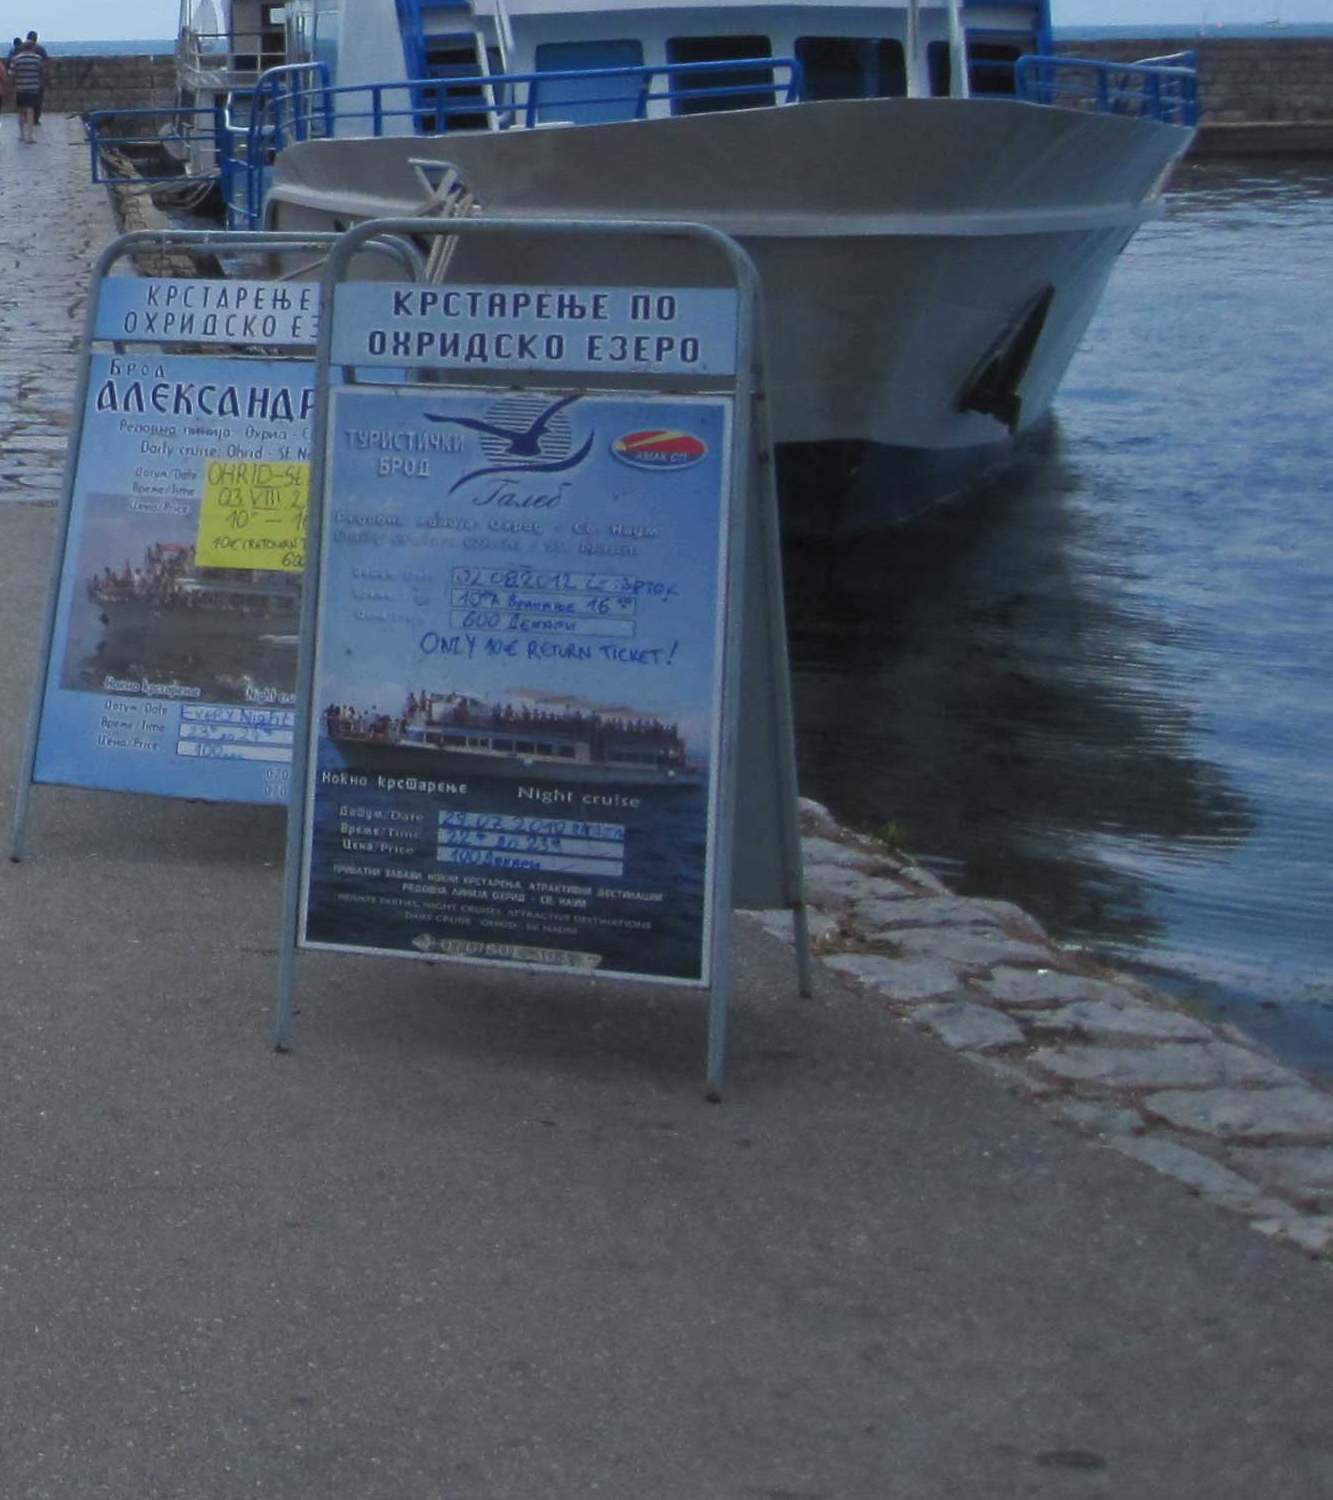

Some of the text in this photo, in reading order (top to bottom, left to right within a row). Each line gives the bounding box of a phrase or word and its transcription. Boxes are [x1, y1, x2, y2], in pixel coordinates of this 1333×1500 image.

[147, 285, 312, 311] КРСТАРЕЊЕ
[392, 290, 677, 321] КРСТАРЕЊЕ ПО
[123, 310, 277, 338] ОХРИДСКО
[367, 329, 701, 365] ОХРИДСКО ЕЗЕРО
[140, 440, 174, 458] Daily
[226, 443, 263, 459] Ohrid
[344, 429, 465, 454] ТУРИСТИЧКИ
[377, 455, 431, 478] БРОД
[471, 478, 573, 510] Галеб
[419, 631, 477, 658] ONLY
[528, 640, 591, 660] RETURN
[517, 785, 641, 809] Night cruise
